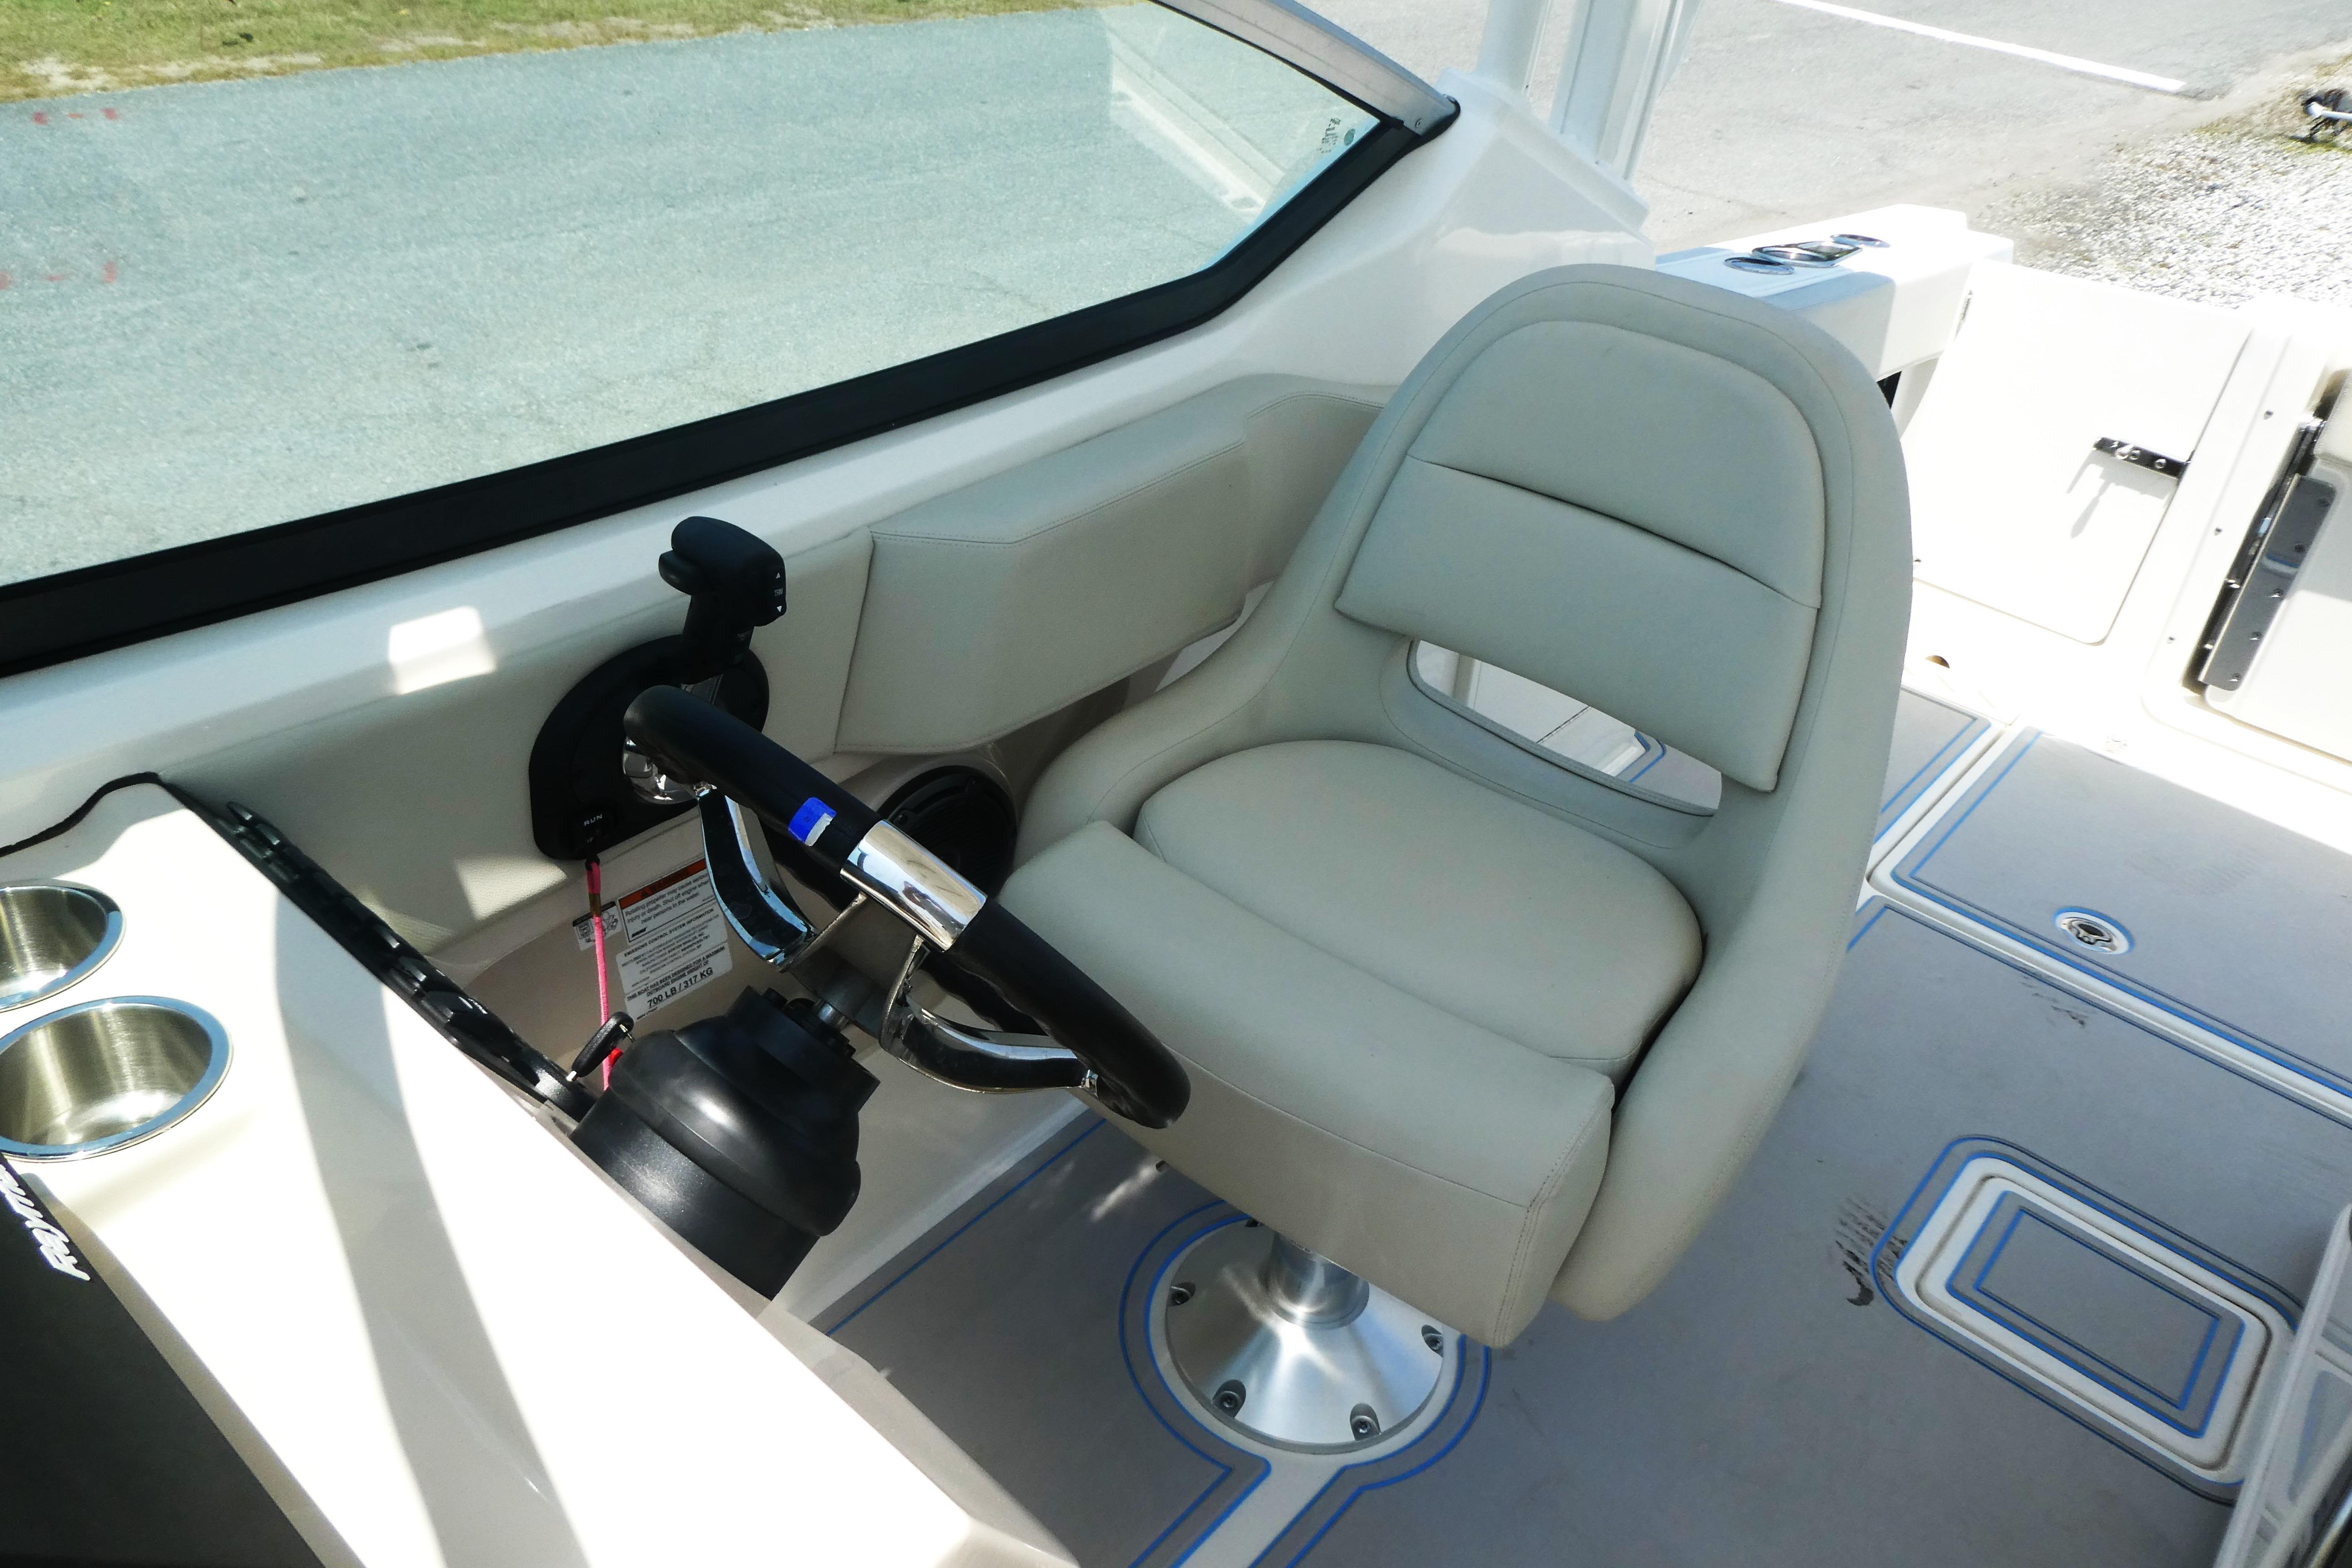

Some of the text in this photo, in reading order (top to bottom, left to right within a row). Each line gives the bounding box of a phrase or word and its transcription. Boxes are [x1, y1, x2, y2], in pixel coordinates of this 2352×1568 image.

[584, 813, 603, 826] RUN
[625, 904, 646, 916] Rotating
[646, 894, 666, 908] propeller
[667, 888, 678, 896] may
[678, 881, 692, 890] cause
[662, 897, 675, 906] Shut
[681, 886, 697, 896] engine
[641, 915, 652, 924] near
[653, 905, 673, 919] persons
[648, 931, 668, 945] CONTROL
[669, 922, 686, 934] SYSTEM
[686, 907, 714, 925] INFORMATION
[627, 993, 637, 1002] THIS
[637, 986, 649, 996] BOAT
[650, 981, 659, 989] HAS
[660, 975, 671, 984] BEEN
[647, 981, 671, 997] OUTBOARD
[671, 972, 687, 984] ENGINE
[647, 994, 663, 1007] 700
[665, 986, 676, 999] LB
[683, 975, 697, 988] 317
[700, 966, 713, 979] KG
